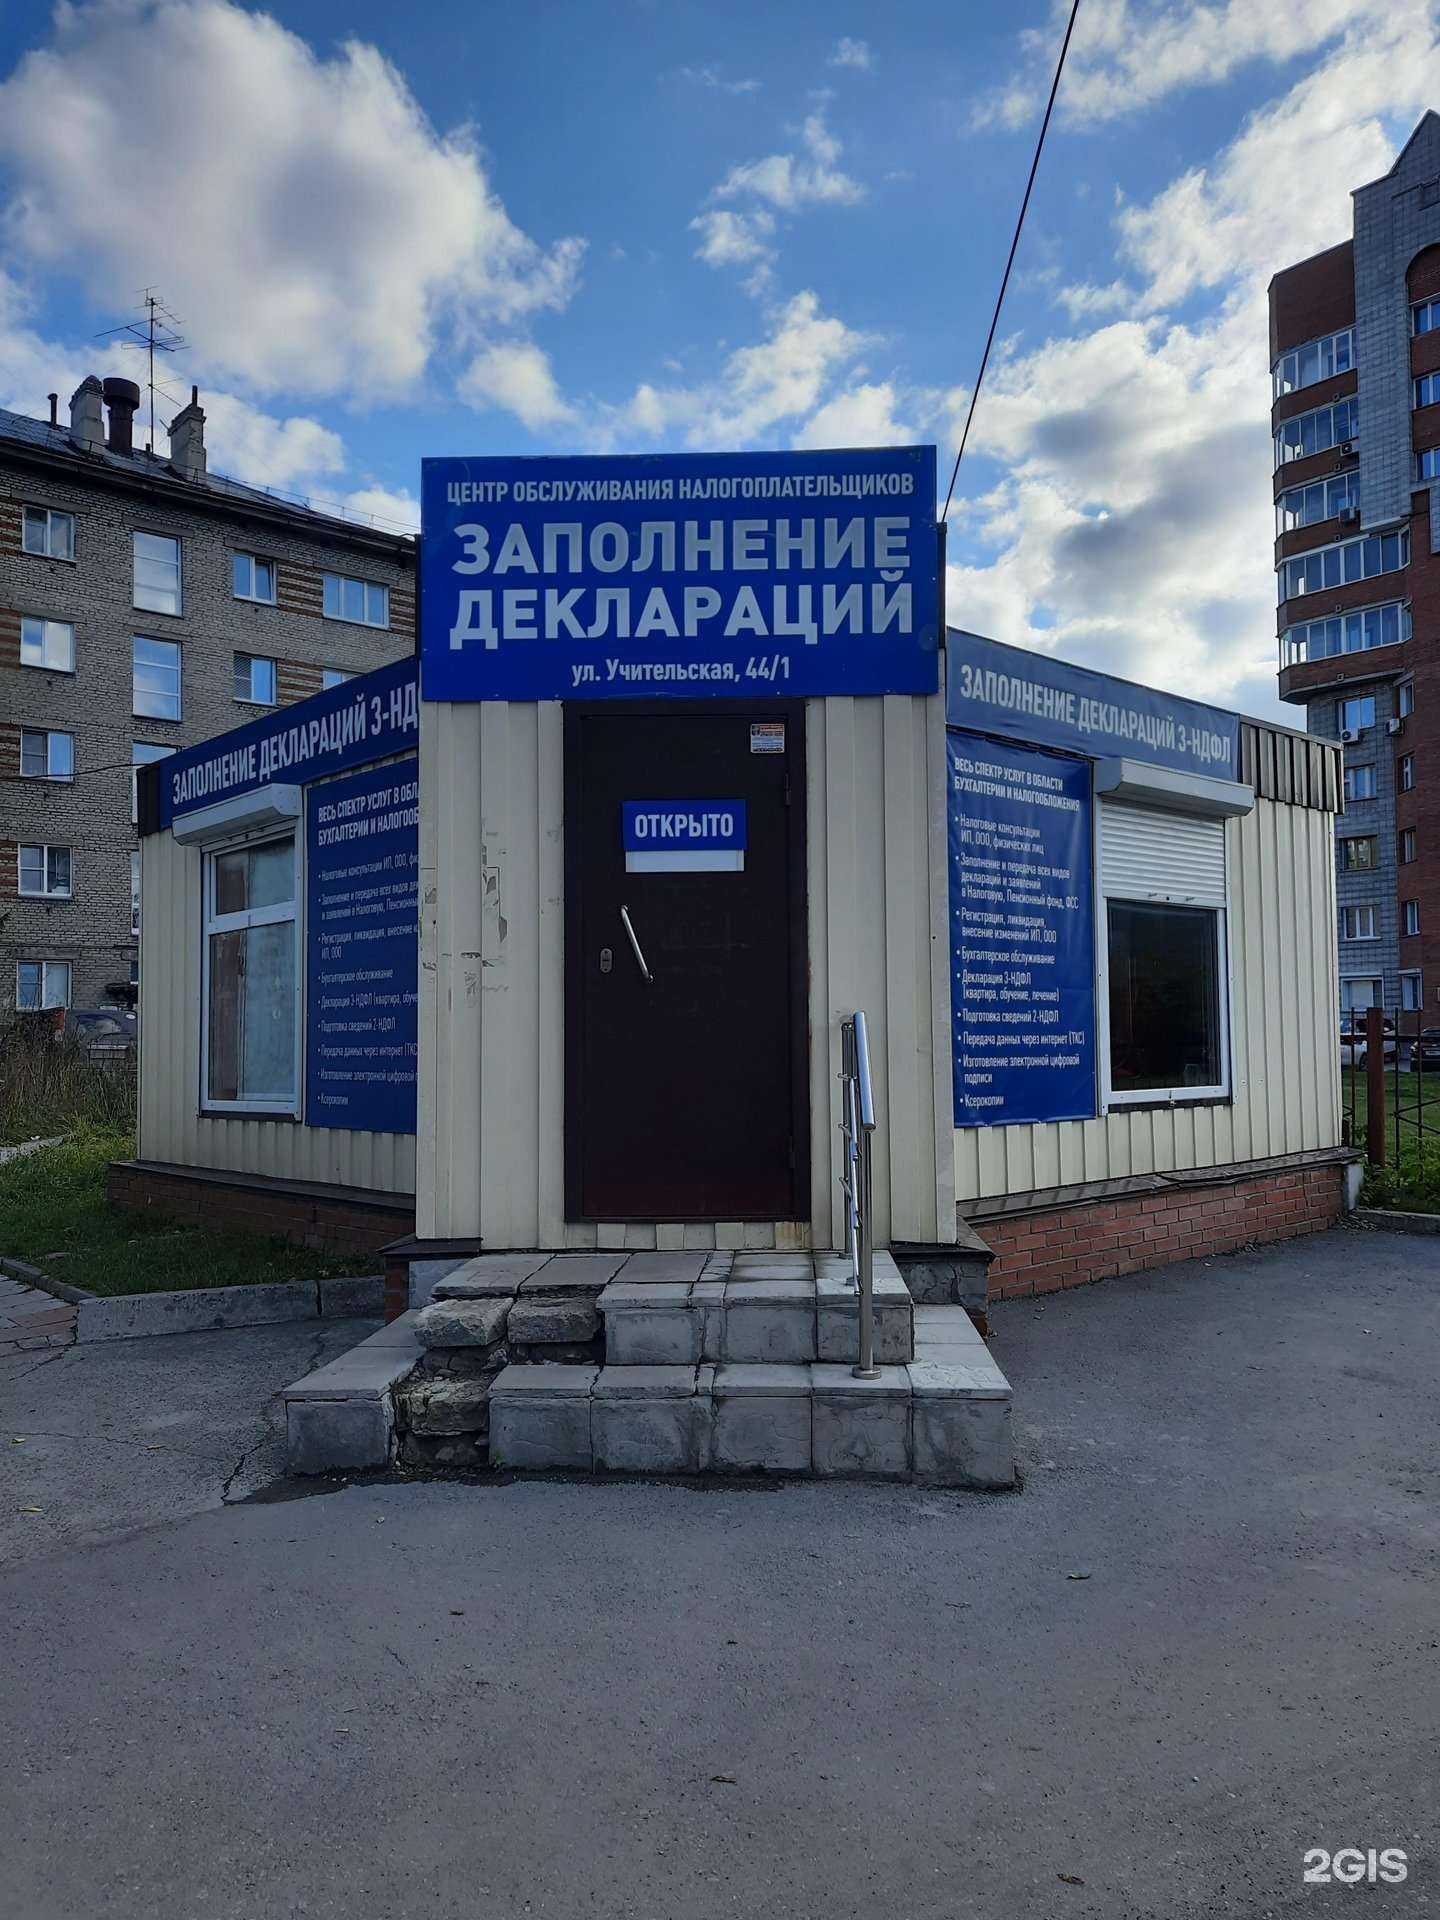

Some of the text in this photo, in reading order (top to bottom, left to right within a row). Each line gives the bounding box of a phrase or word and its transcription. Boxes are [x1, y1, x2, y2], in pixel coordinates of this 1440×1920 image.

[448, 473, 914, 506] ЦЕНТР ОБСЛУЖИВАНИЯ НАЛОГОПЛАТЕЛЬЩИКОВ
[452, 516, 911, 576] ЗАПОЛНЕНИЕ
[449, 569, 913, 650] ДЕКЛАРАЦИЙ
[572, 656, 790, 687] ул. Учительская, 44/1
[960, 664, 1075, 724] ЗАПОЛНЕНИЕ
[1078, 698, 1175, 752] ДЕКЛАРАЦИЙ
[172, 681, 420, 805] ЗАПОЛНЕНИЕ ДЕКЛАРАЦИЙ 3-НД
[955, 757, 1063, 791] ВЕСЬ СПЕКТР УСЛУГ В ОБЛАСТИ
[318, 782, 418, 823] ВЕСЬ СПЕКТР УСЛУГ В ОБЛ
[955, 776, 1080, 812] БУХГАЛТЕРИИ И НАЛОГООБЛОЖЕНИЯ
[318, 819, 368, 846] БУХГАЛТЕРИИ
[370, 817, 376, 834] И
[635, 814, 734, 838] ОТКРЫТО
